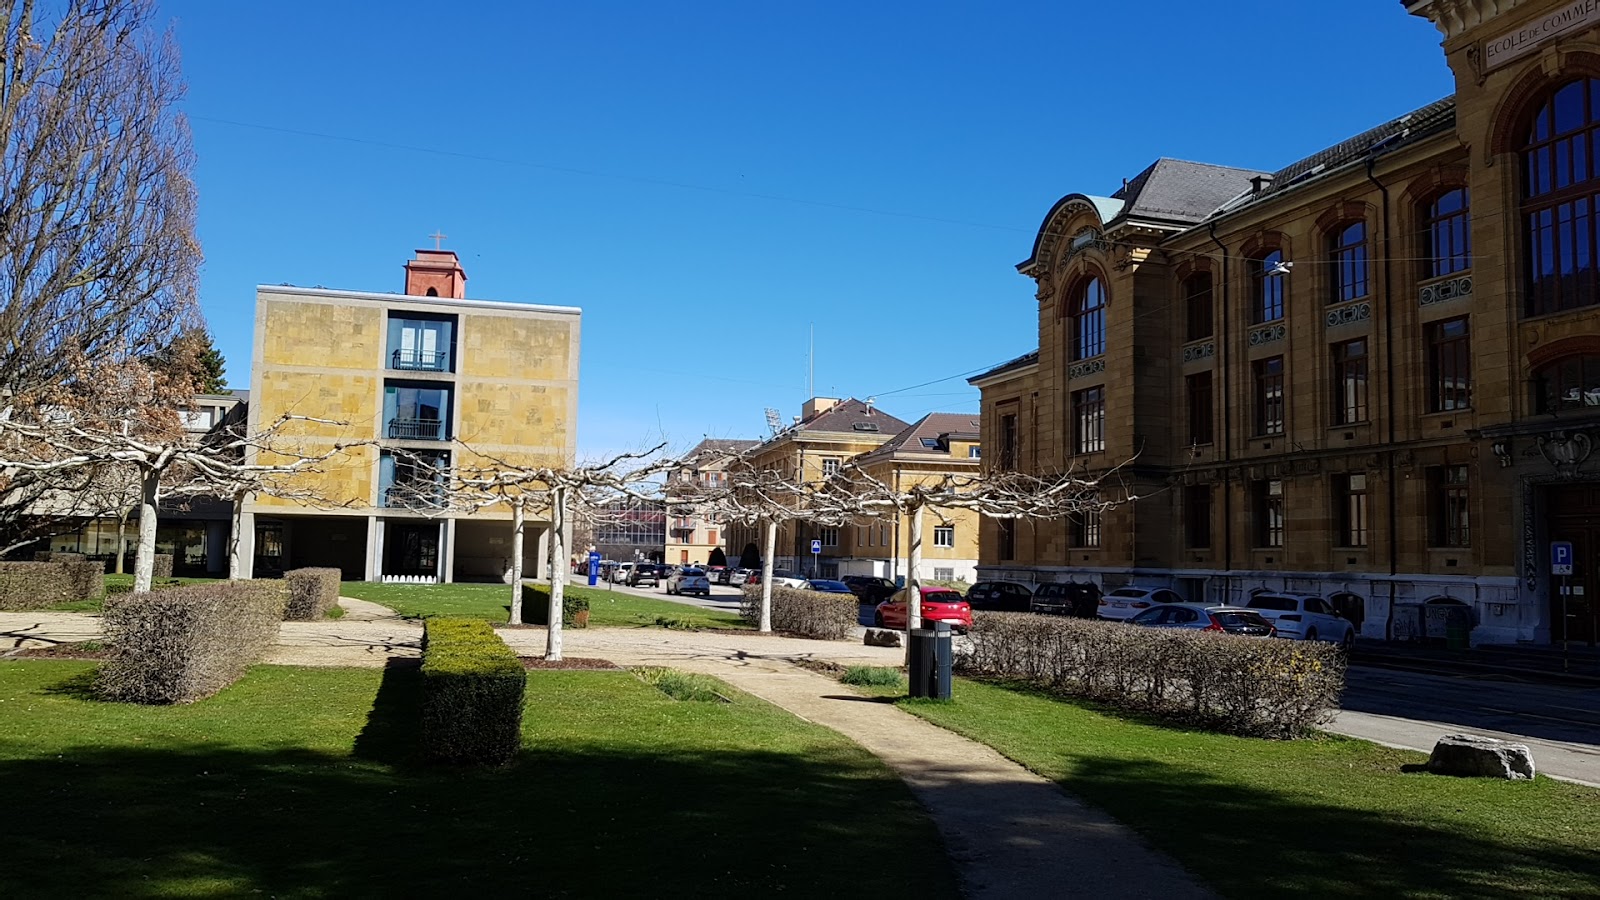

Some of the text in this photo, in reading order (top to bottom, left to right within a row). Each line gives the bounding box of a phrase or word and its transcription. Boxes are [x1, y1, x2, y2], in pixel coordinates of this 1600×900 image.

[1487, 30, 1527, 58] ECOLE
[1529, 27, 1540, 39] DE
[1557, 547, 1567, 563] P
